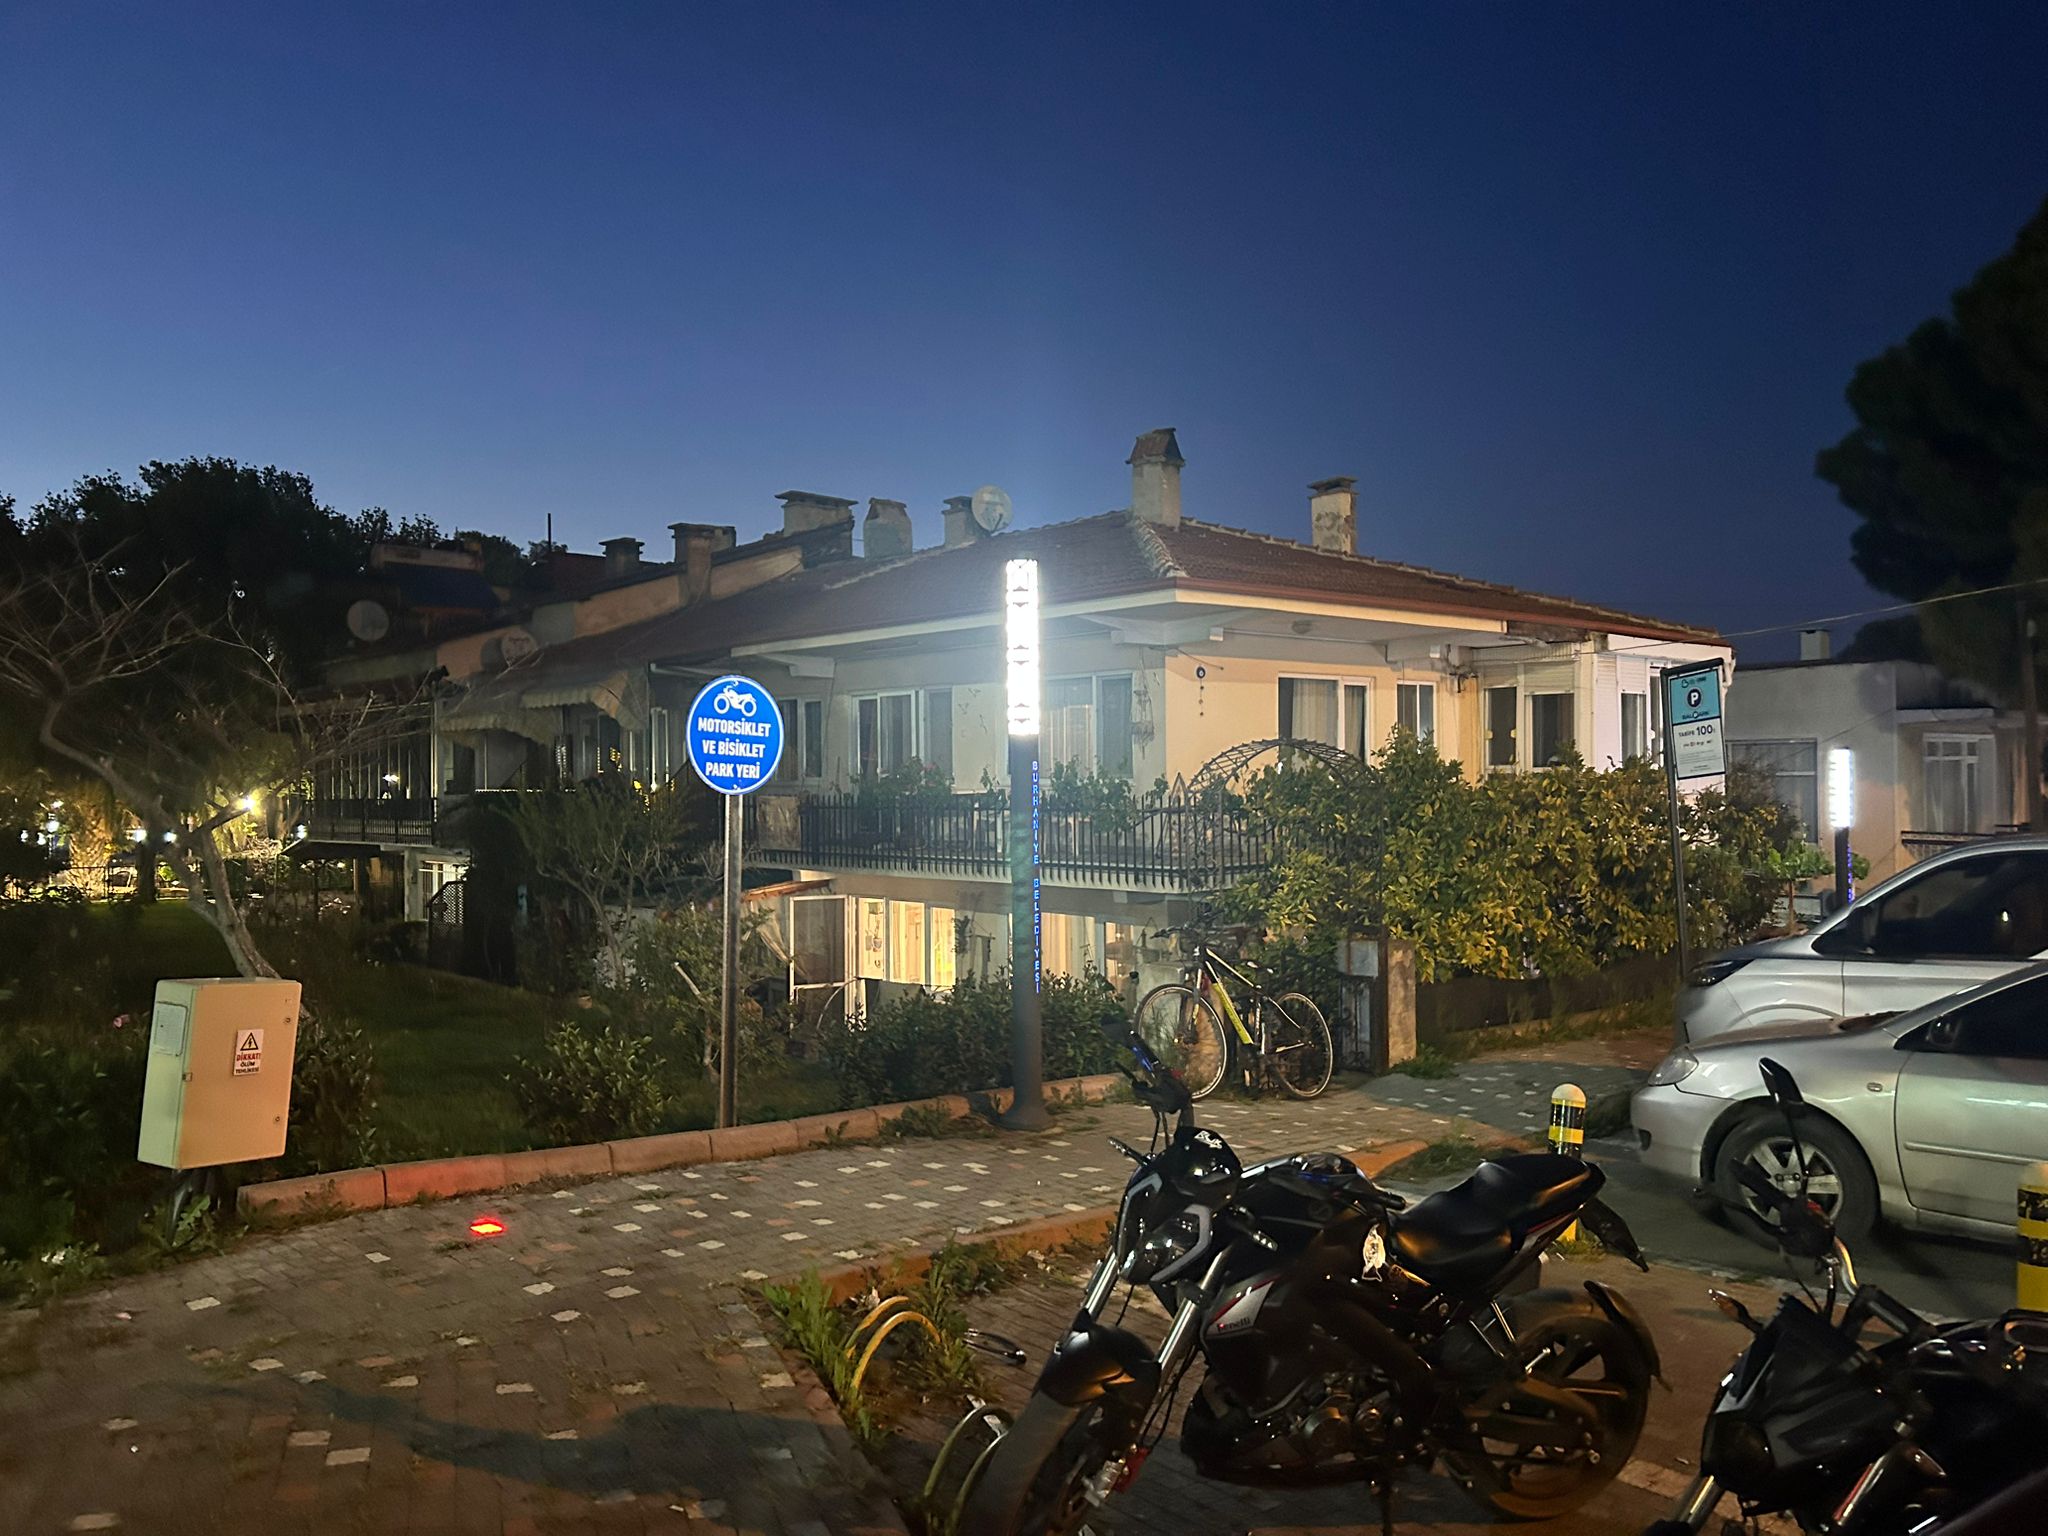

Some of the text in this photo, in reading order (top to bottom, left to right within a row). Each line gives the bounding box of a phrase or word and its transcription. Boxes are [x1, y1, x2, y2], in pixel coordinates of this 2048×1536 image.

[1690, 692, 1699, 705] P
[698, 717, 771, 737] MOTORSİKLET
[702, 738, 766, 758] VE BİSİKLET
[705, 761, 760, 779] PARK YERİ
